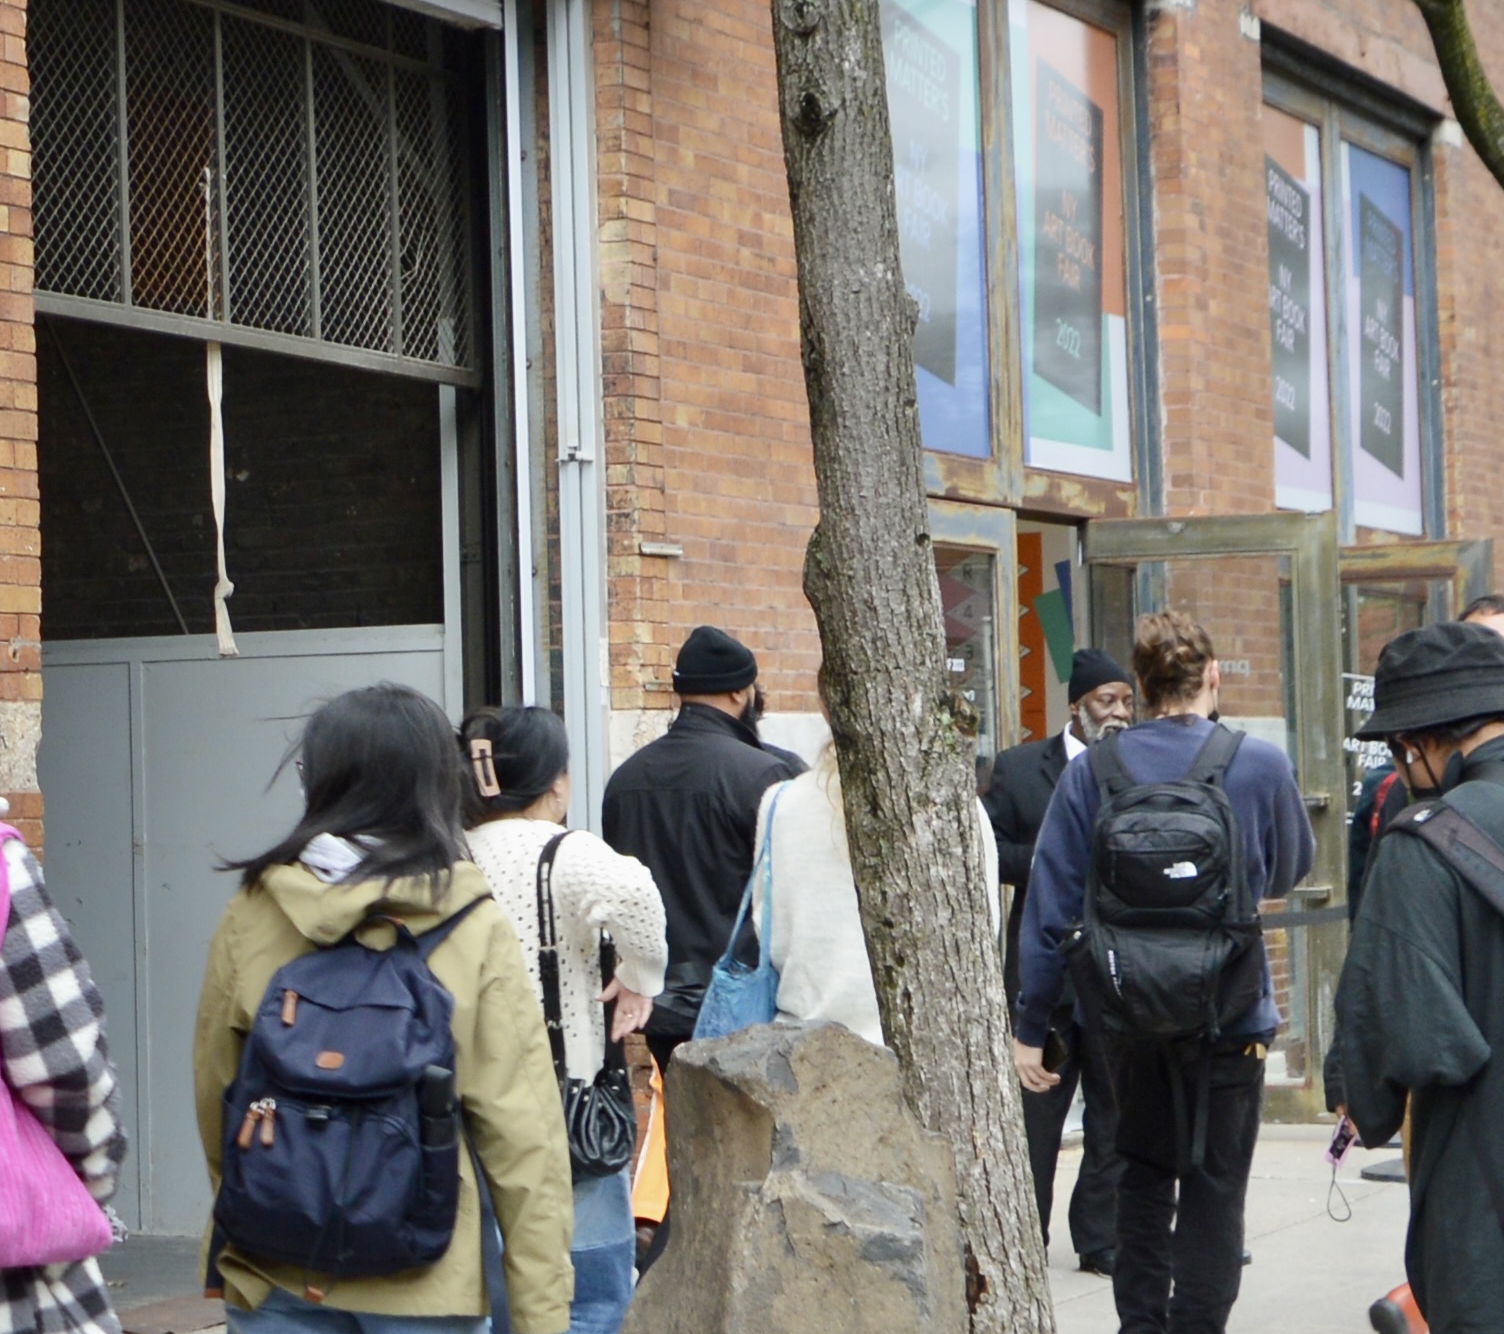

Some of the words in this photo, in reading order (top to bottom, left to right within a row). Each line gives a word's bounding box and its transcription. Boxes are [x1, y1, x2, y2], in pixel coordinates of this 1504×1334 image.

[894, 19, 946, 82] PRINTED
[1047, 79, 1092, 137] PRINTED
[909, 139, 928, 170] NY
[896, 165, 912, 199] RT
[914, 176, 948, 226] BOOK
[1060, 189, 1078, 218] NY
[1268, 169, 1302, 218] PRINTED
[903, 205, 930, 251] FAIR
[1043, 210, 1064, 248] ART
[1065, 225, 1095, 270] BOOK
[1057, 252, 1080, 292] FAIR
[1278, 264, 1292, 292] NY
[1283, 294, 1305, 335] BOOK
[1055, 317, 1081, 359] 2022
[1276, 319, 1294, 353] FAIR
[1379, 330, 1399, 363] BOOK
[1373, 349, 1391, 381] FAIR
[1276, 375, 1296, 411] 2022
